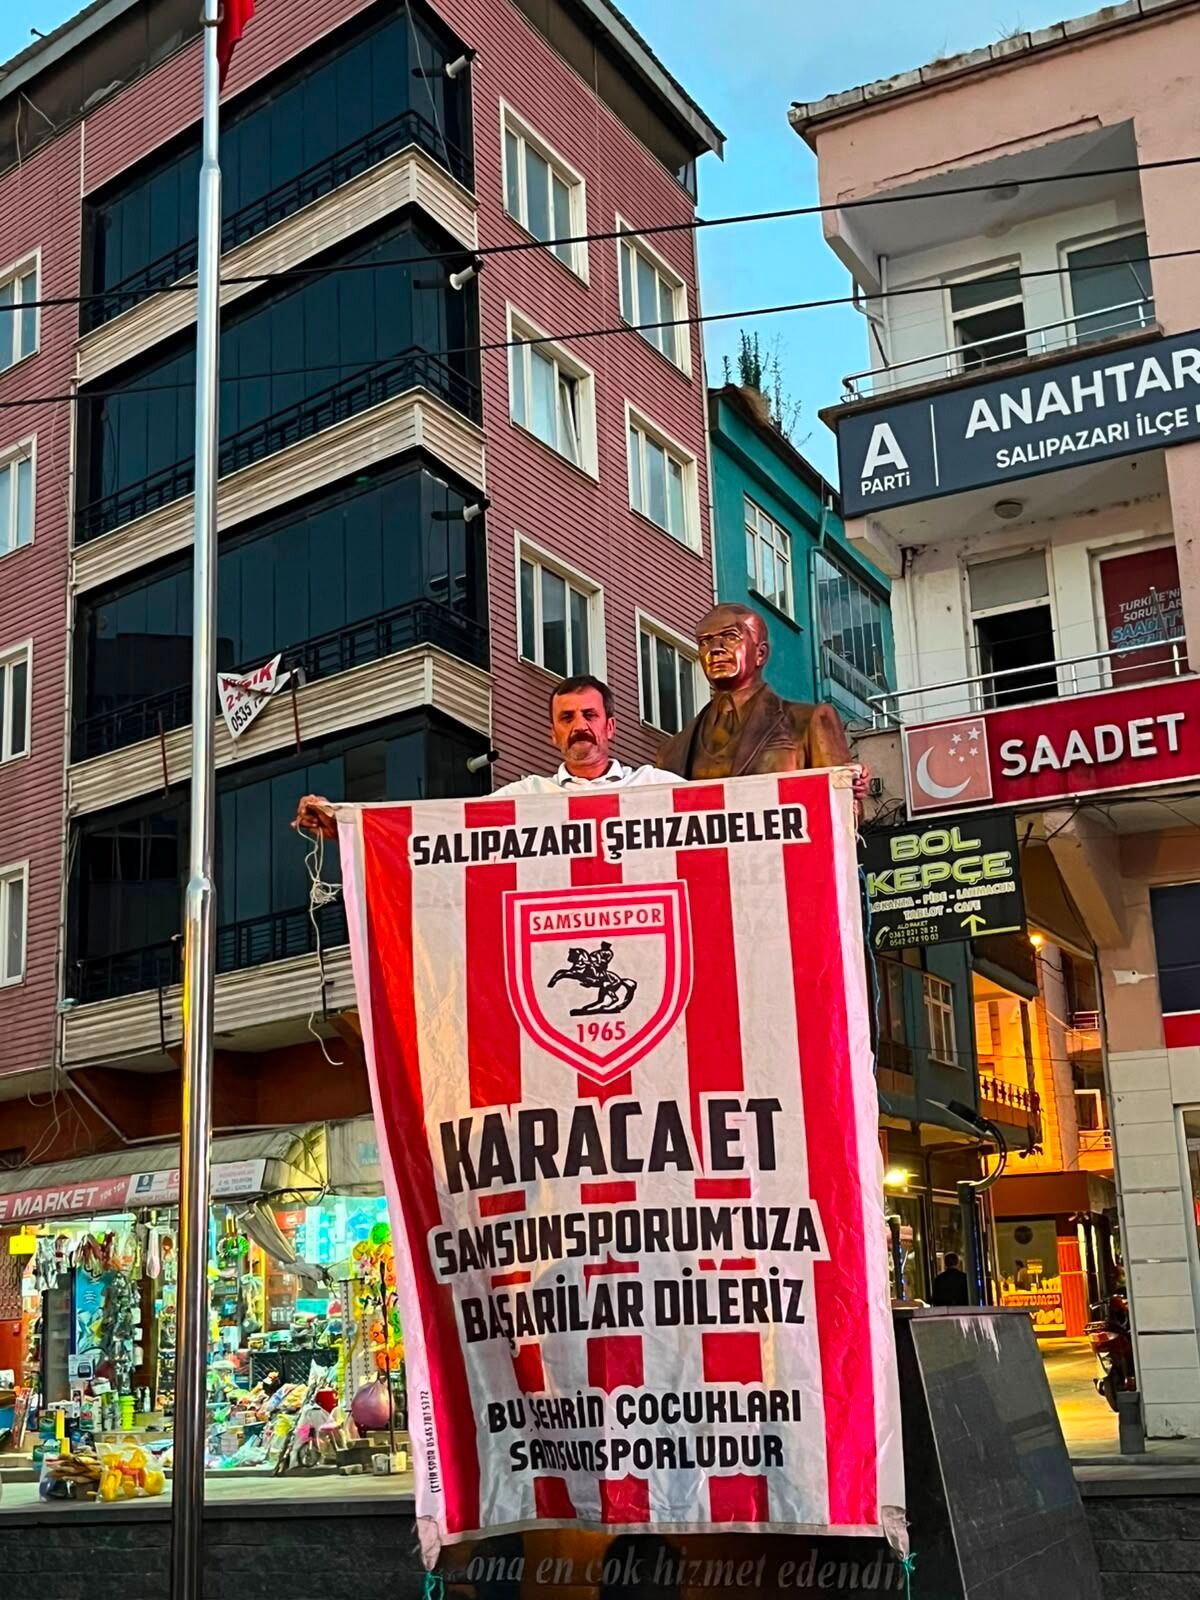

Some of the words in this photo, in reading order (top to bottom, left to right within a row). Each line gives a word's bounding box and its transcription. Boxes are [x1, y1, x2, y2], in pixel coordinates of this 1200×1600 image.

[965, 348, 1200, 439] ANAHTAR
[861, 422, 909, 478] A
[996, 421, 1130, 469] SALIPAZARI
[1136, 407, 1190, 436] İLÇE
[1000, 712, 1185, 777] SAADET
[413, 822, 593, 866] SALIPAZARI
[607, 806, 804, 860] ŞEHZADELER
[890, 826, 981, 861] BOL
[868, 851, 1013, 896] KEPÇE
[532, 907, 662, 932] SAMSUNSPOR
[577, 1021, 626, 1043] 1965
[439, 1099, 694, 1195] KARACA
[708, 1097, 782, 1171] ET
[12, 1187, 99, 1217] MARKET
[654, 1266, 805, 1327] DİLERİZ
[488, 1398, 527, 1433] BU
[615, 1389, 801, 1430] ÇOCUKLARI
[509, 1434, 784, 1473] SAMSUNSPORLUDUR
[536, 1557, 574, 1584] en
[653, 1546, 767, 1588] hizmet
